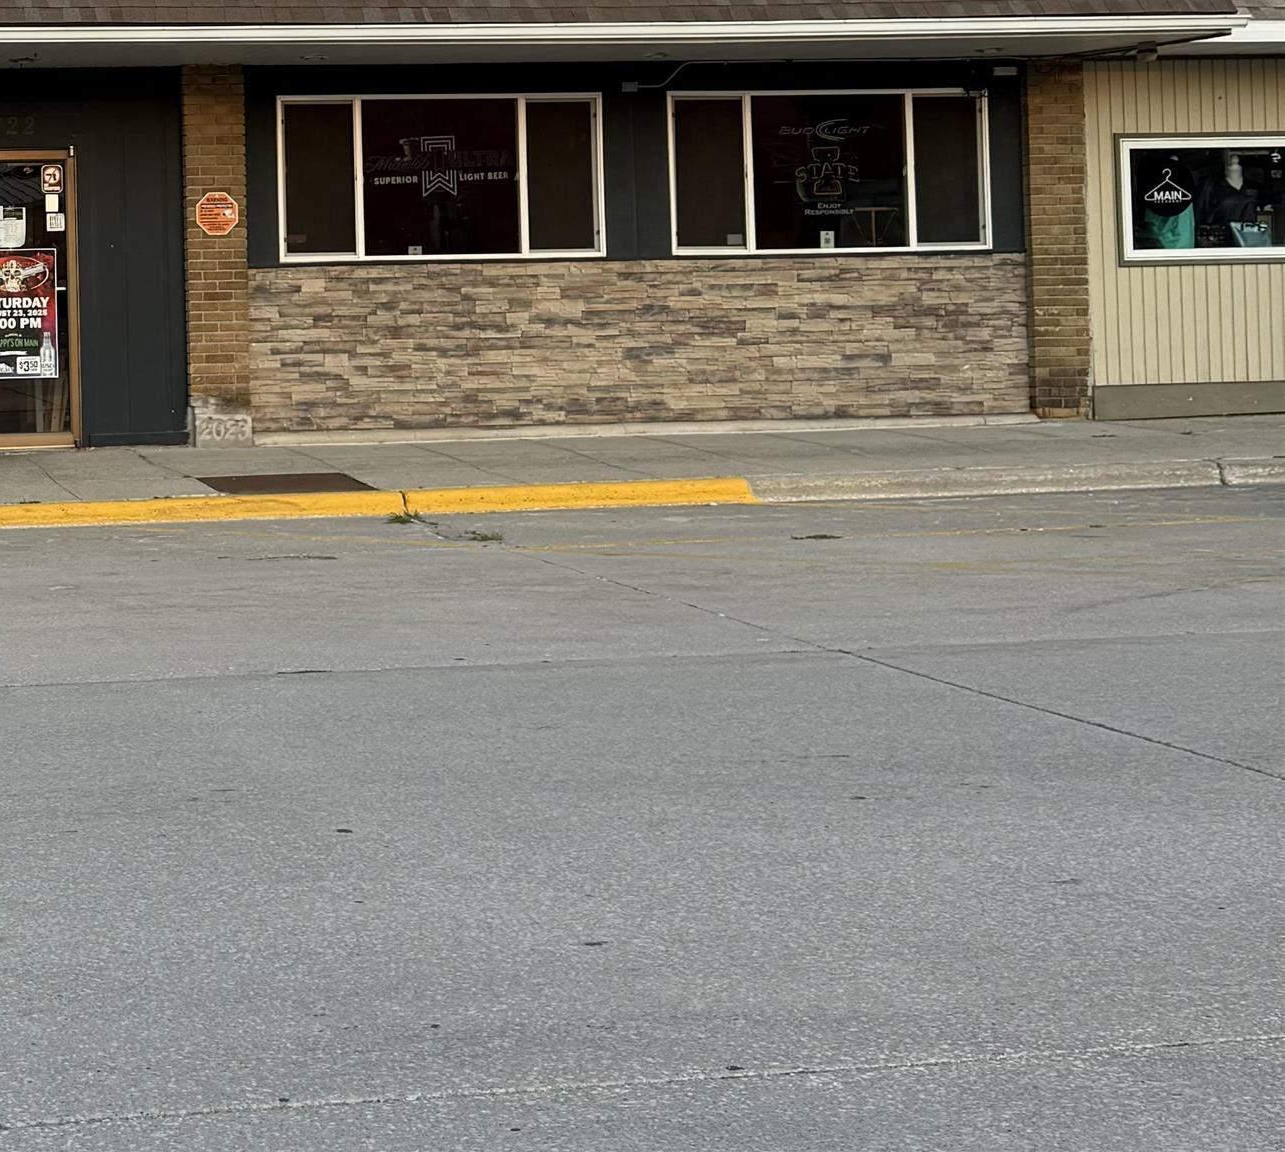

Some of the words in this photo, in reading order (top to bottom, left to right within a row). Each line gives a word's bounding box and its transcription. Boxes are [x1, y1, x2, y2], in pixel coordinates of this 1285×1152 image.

[795, 162, 860, 183] STATE
[373, 176, 419, 185] SUPERIOR
[458, 173, 485, 181] LIGHT
[487, 172, 509, 180] BEER
[1154, 191, 1182, 201] MAIN
[13, 309, 25, 317] 23,
[20, 318, 42, 329] PM
